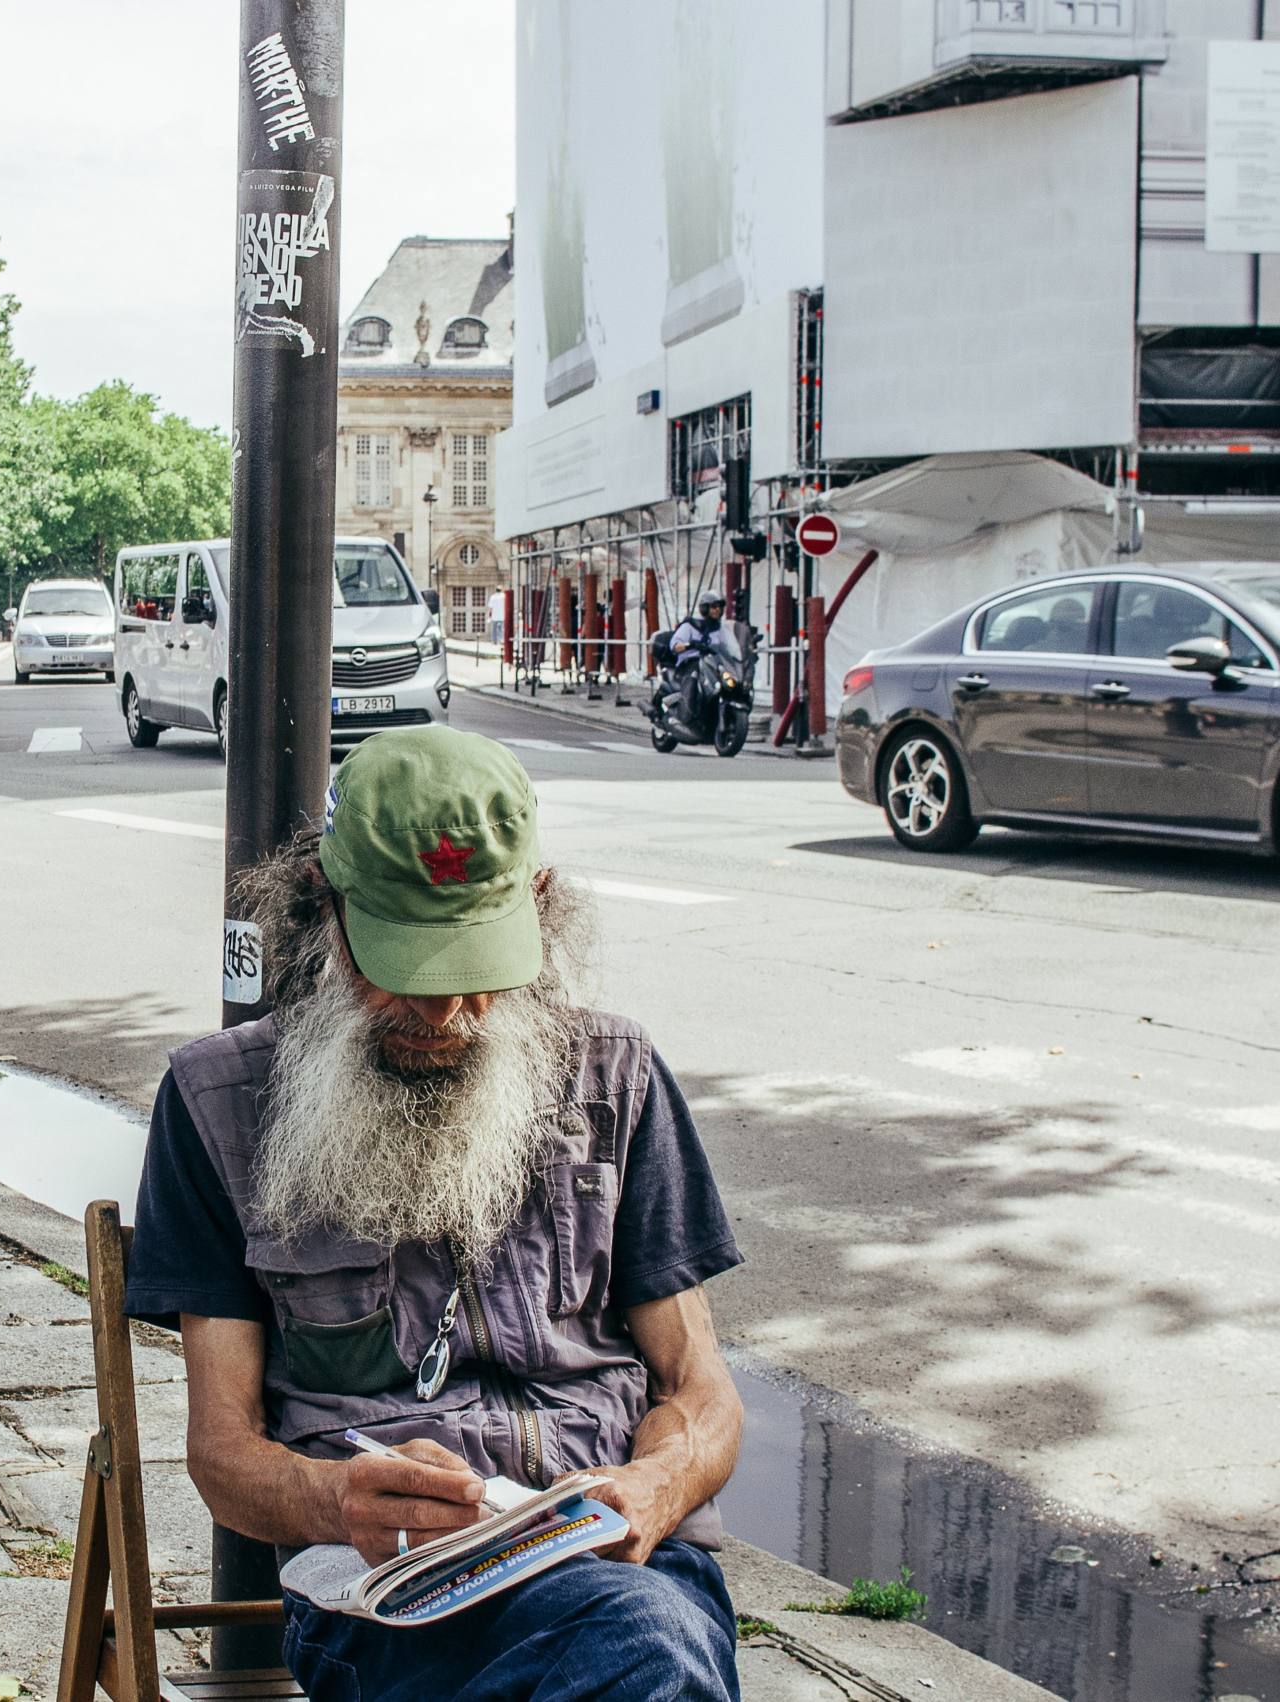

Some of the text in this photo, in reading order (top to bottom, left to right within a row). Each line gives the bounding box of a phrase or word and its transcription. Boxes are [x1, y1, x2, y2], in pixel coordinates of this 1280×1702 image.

[247, 32, 316, 152] MARTHE
[500, 1515, 594, 1560] ENIGMISTICA
[557, 1521, 603, 1544] NUOVI
[472, 1556, 499, 1574] VIP
[506, 1540, 555, 1567] GIOCHI
[453, 1564, 504, 1598] NUOVA
[455, 1572, 470, 1584] SI
